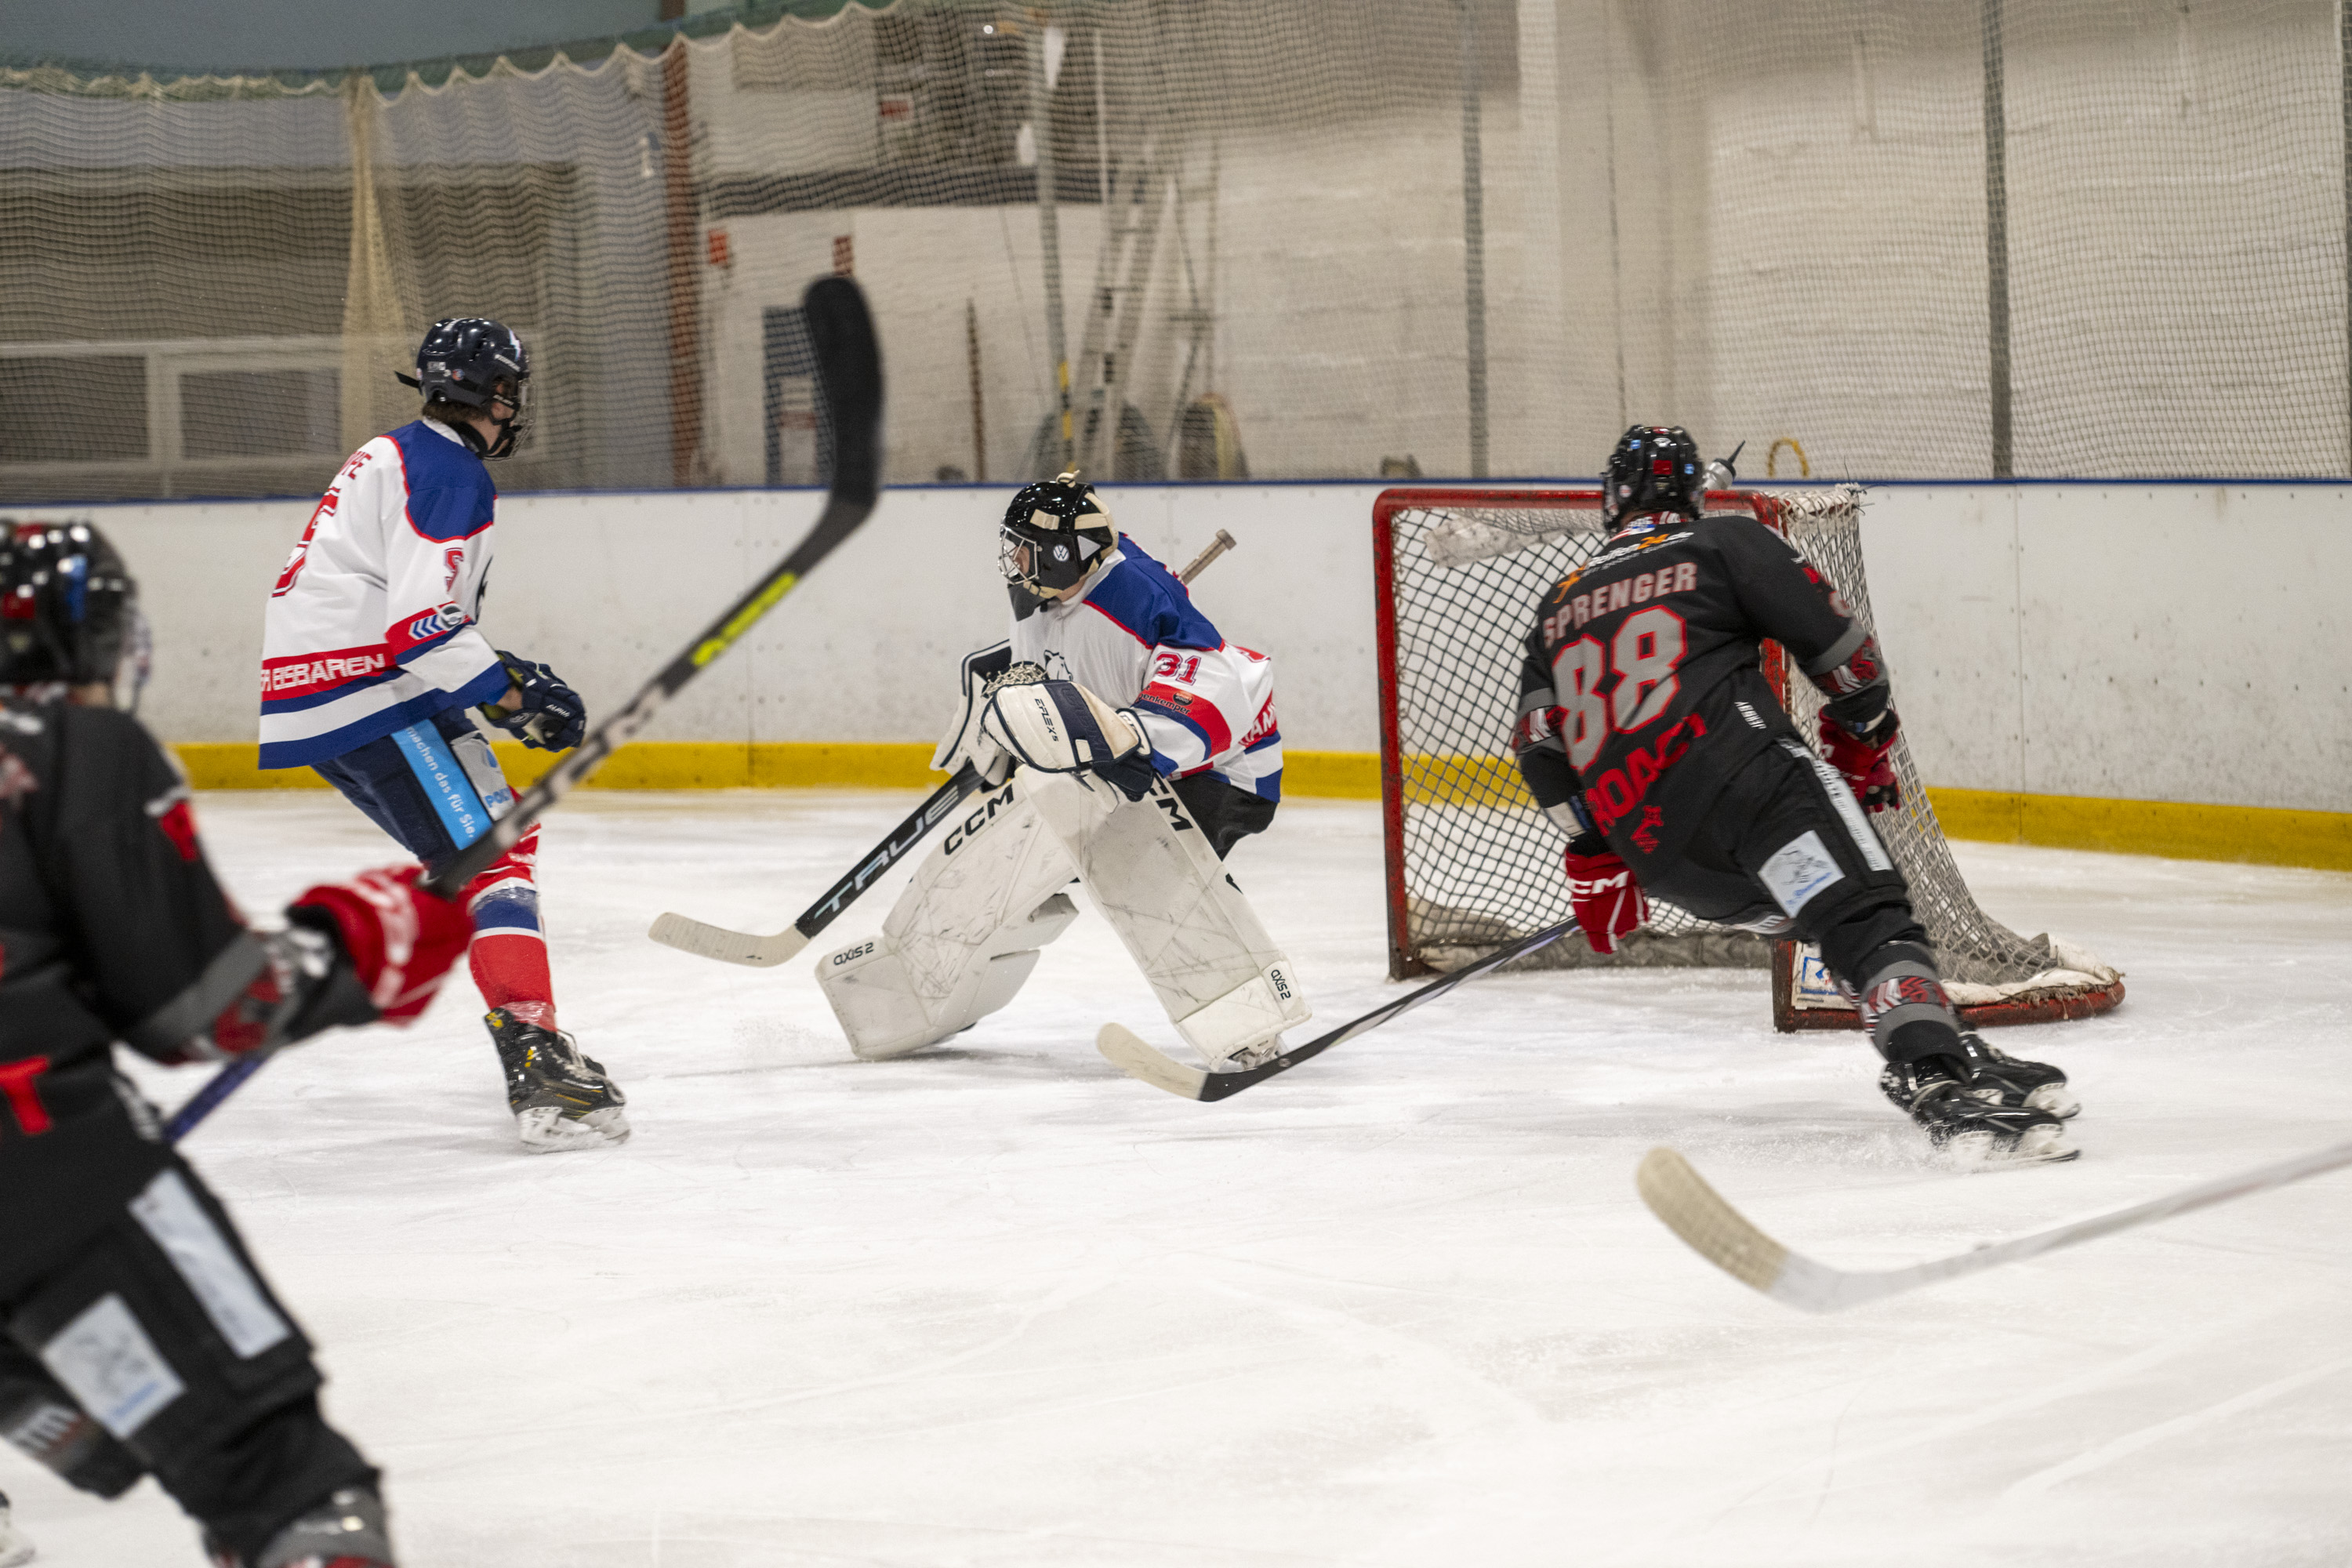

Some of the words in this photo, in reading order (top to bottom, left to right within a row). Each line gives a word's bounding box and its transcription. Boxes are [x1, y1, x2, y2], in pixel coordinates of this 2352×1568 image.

[1542, 561, 1698, 650] SPRENGER
[1154, 651, 1202, 687] 31
[1551, 604, 1689, 777] 88
[406, 726, 439, 771] machen
[434, 772, 452, 793] das
[447, 793, 465, 813] für
[459, 813, 476, 838] Sie.
[943, 783, 1014, 856] CCM
[813, 785, 960, 920] TRUE
[865, 942, 874, 954] 2
